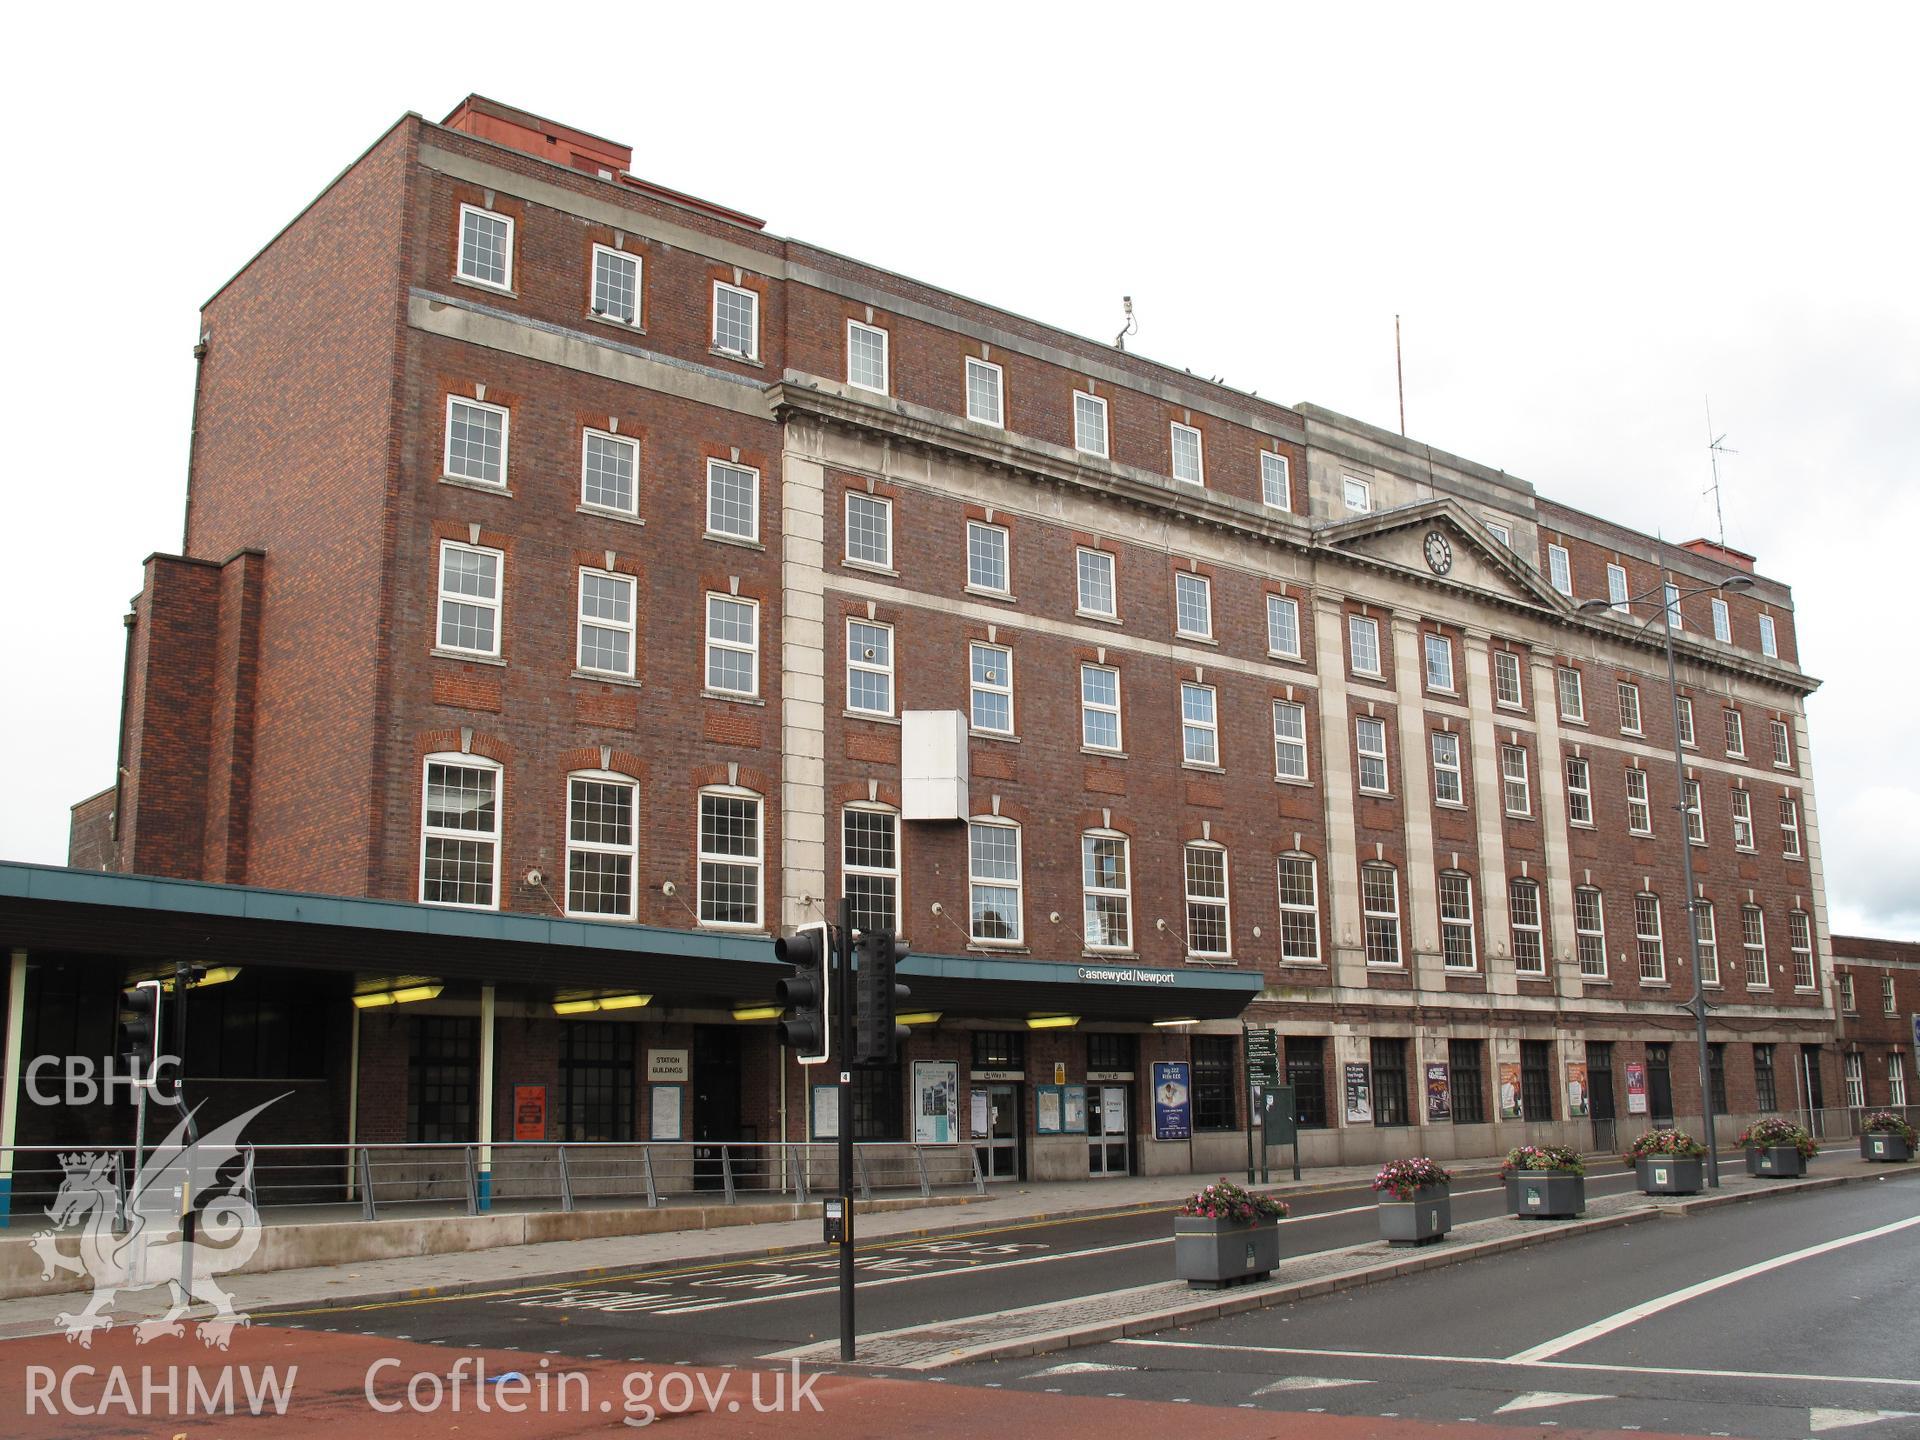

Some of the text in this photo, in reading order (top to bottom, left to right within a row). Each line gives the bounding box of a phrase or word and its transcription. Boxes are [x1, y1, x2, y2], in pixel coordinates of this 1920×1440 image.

[656, 1056, 680, 1064] STATION
[652, 1066, 683, 1074] BUILDINGS
[885, 1240, 1049, 1255] BUS
[754, 1254, 976, 1272] LANE
